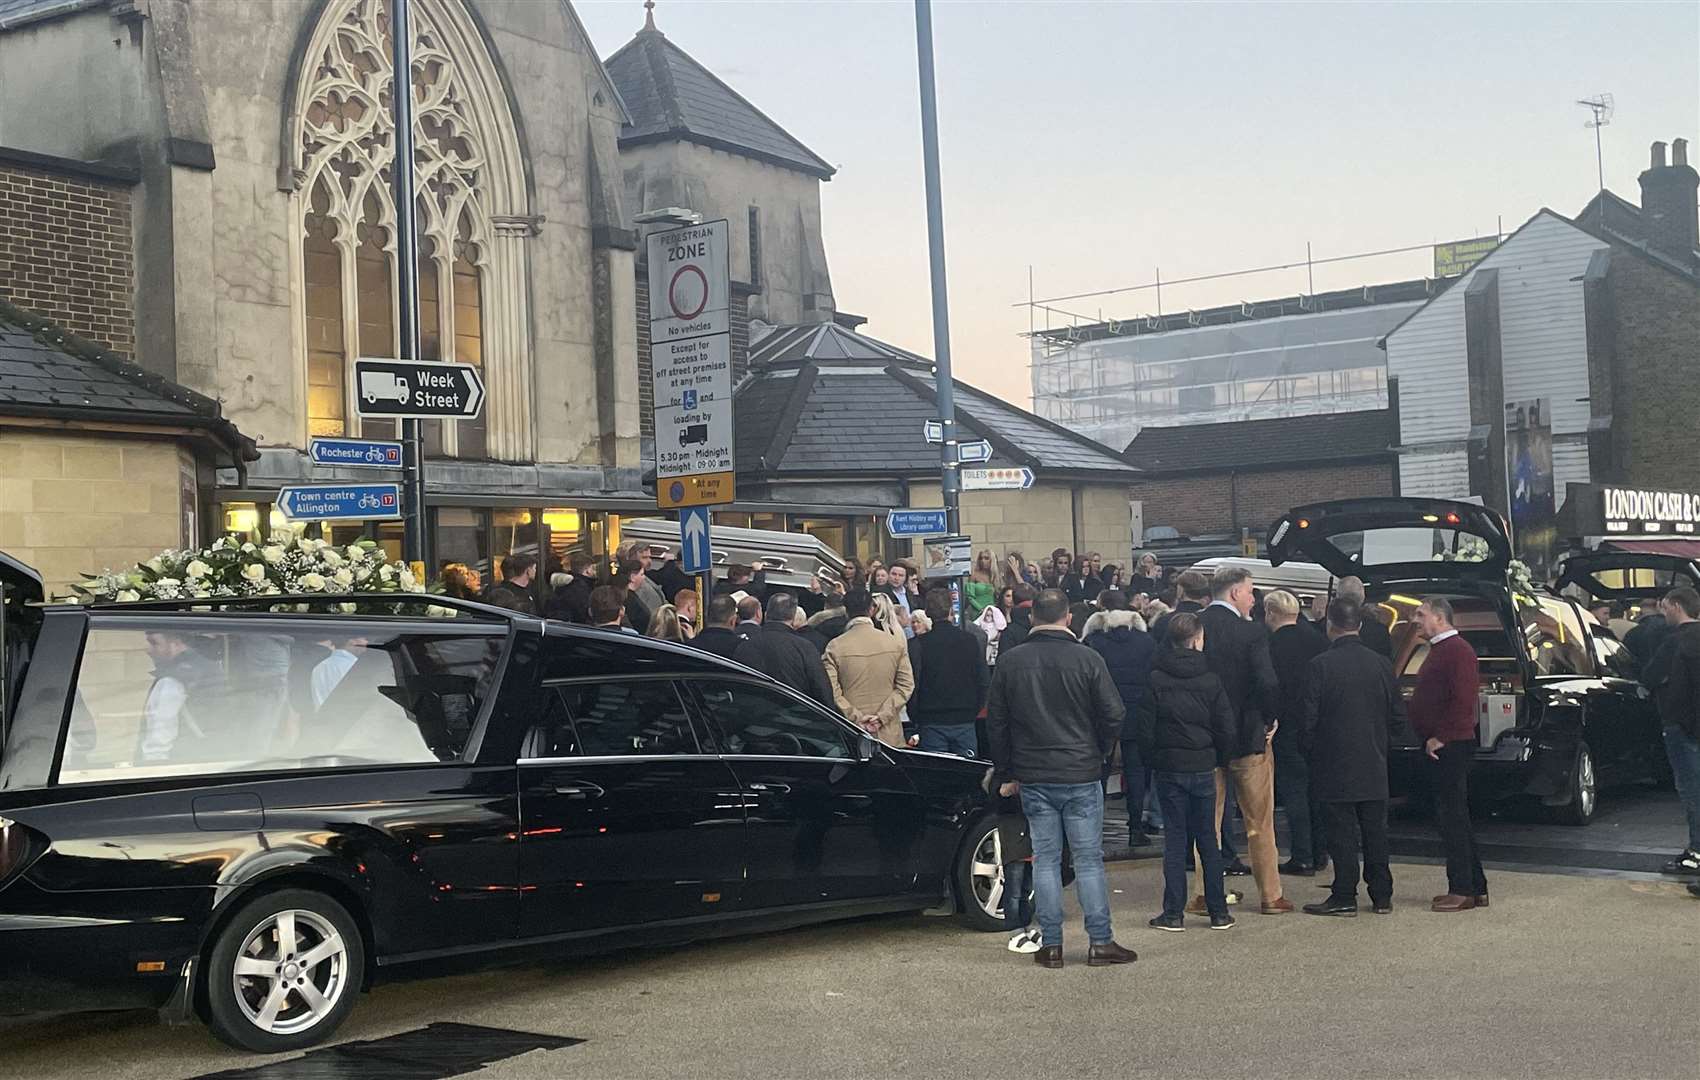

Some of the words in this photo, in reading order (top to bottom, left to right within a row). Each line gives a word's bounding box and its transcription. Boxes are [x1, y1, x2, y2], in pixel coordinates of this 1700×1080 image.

[661, 227, 713, 246] PEDESTRIAN
[668, 242, 706, 262] ZONE
[668, 326, 679, 336] No
[681, 322, 712, 334] vehicles
[671, 343, 696, 354] Except
[698, 341, 710, 349] for
[673, 357, 697, 365] access
[656, 368, 666, 378] off
[668, 366, 690, 376] street
[692, 361, 727, 373] premises
[417, 371, 455, 388] Week
[671, 379, 678, 387] at
[680, 377, 693, 386] any
[696, 375, 712, 384] time
[415, 391, 460, 408] Street
[670, 397, 680, 405] for
[700, 392, 713, 402] and
[673, 413, 700, 424] loading
[702, 412, 711, 421] by
[321, 447, 364, 458] Rochester
[388, 450, 396, 459] 17
[679, 453, 690, 461] pm
[696, 447, 728, 459] Midnight
[660, 462, 690, 473] Midnight
[719, 459, 730, 467] am
[964, 470, 987, 479] TOILETS
[697, 479, 705, 488] At
[707, 479, 720, 488] any
[294, 492, 320, 501] Town
[324, 492, 355, 500] centre
[384, 496, 392, 504] 17
[701, 490, 716, 498] time
[296, 503, 340, 513] Allington
[1604, 488, 1654, 520] LONDON
[1654, 491, 1682, 521] CASH
[1684, 493, 1693, 521] &
